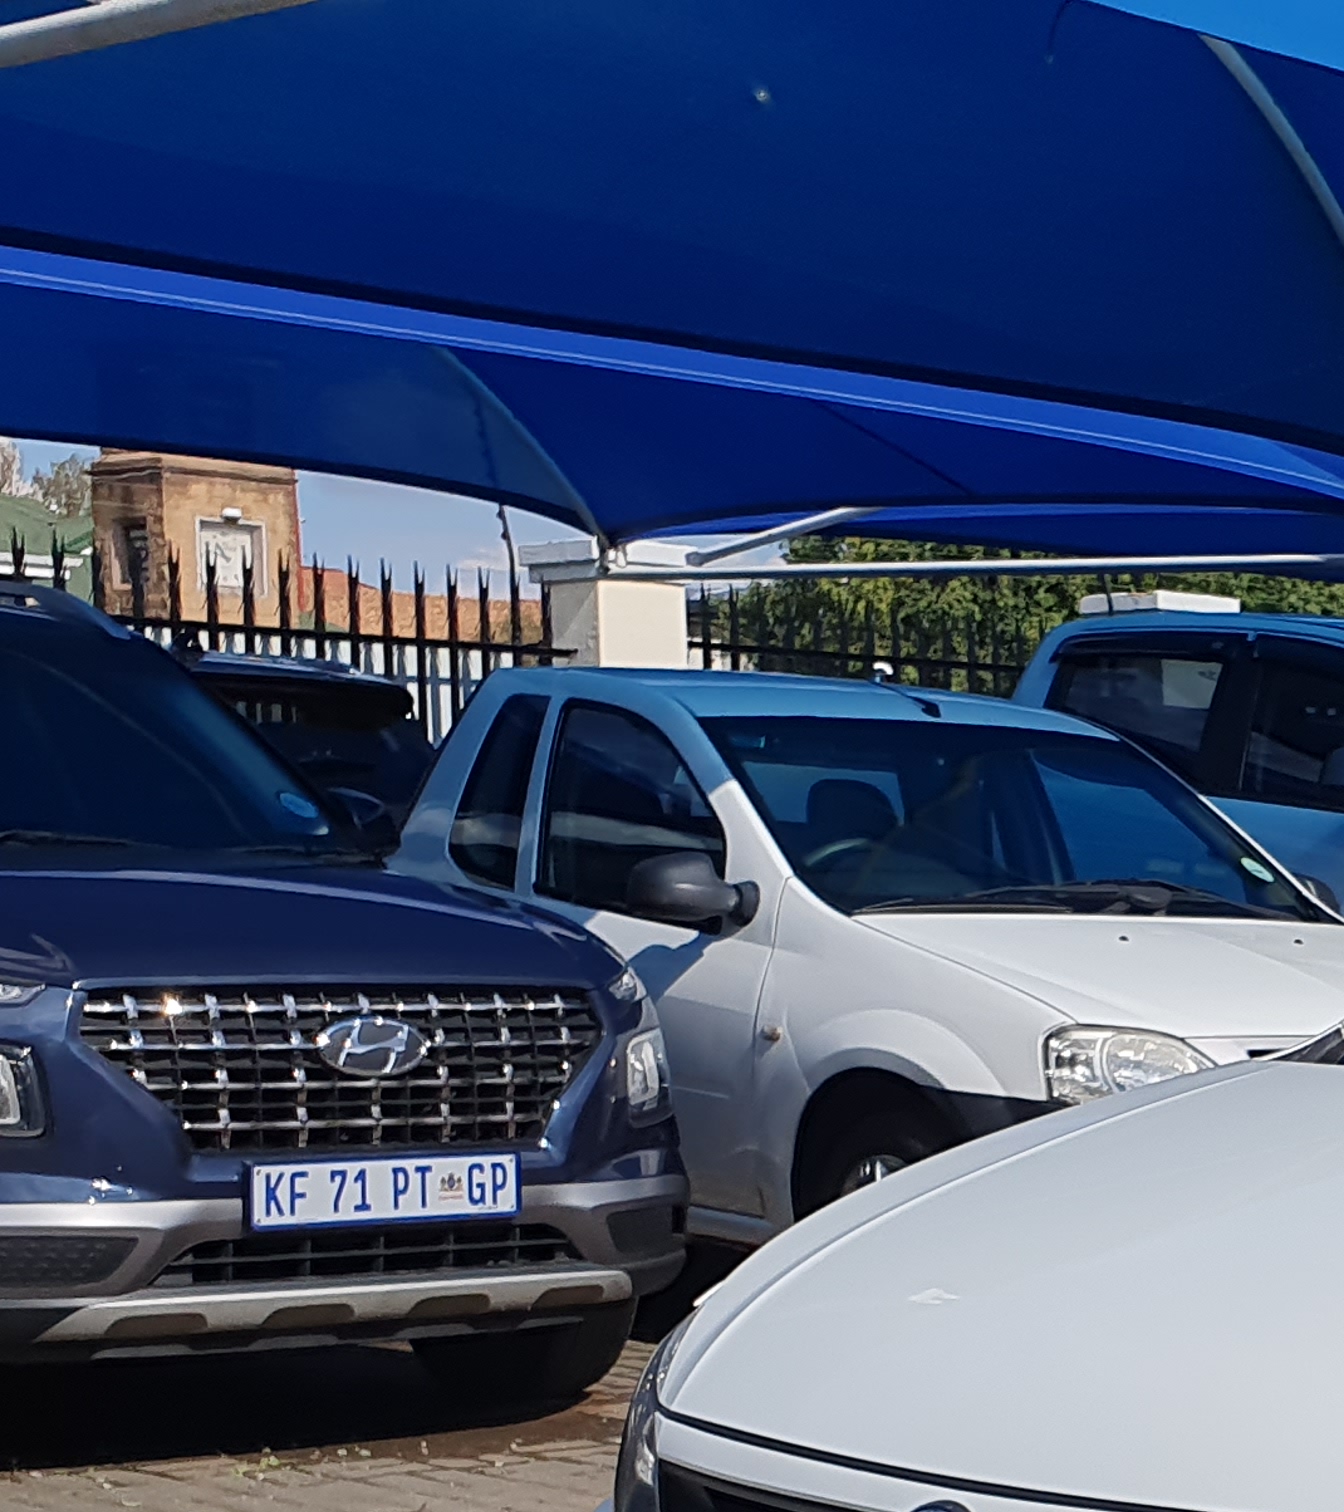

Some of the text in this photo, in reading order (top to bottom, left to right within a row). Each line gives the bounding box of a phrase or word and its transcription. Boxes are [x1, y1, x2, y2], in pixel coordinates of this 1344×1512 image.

[264, 1162, 508, 1217] KF 71 PT GP
